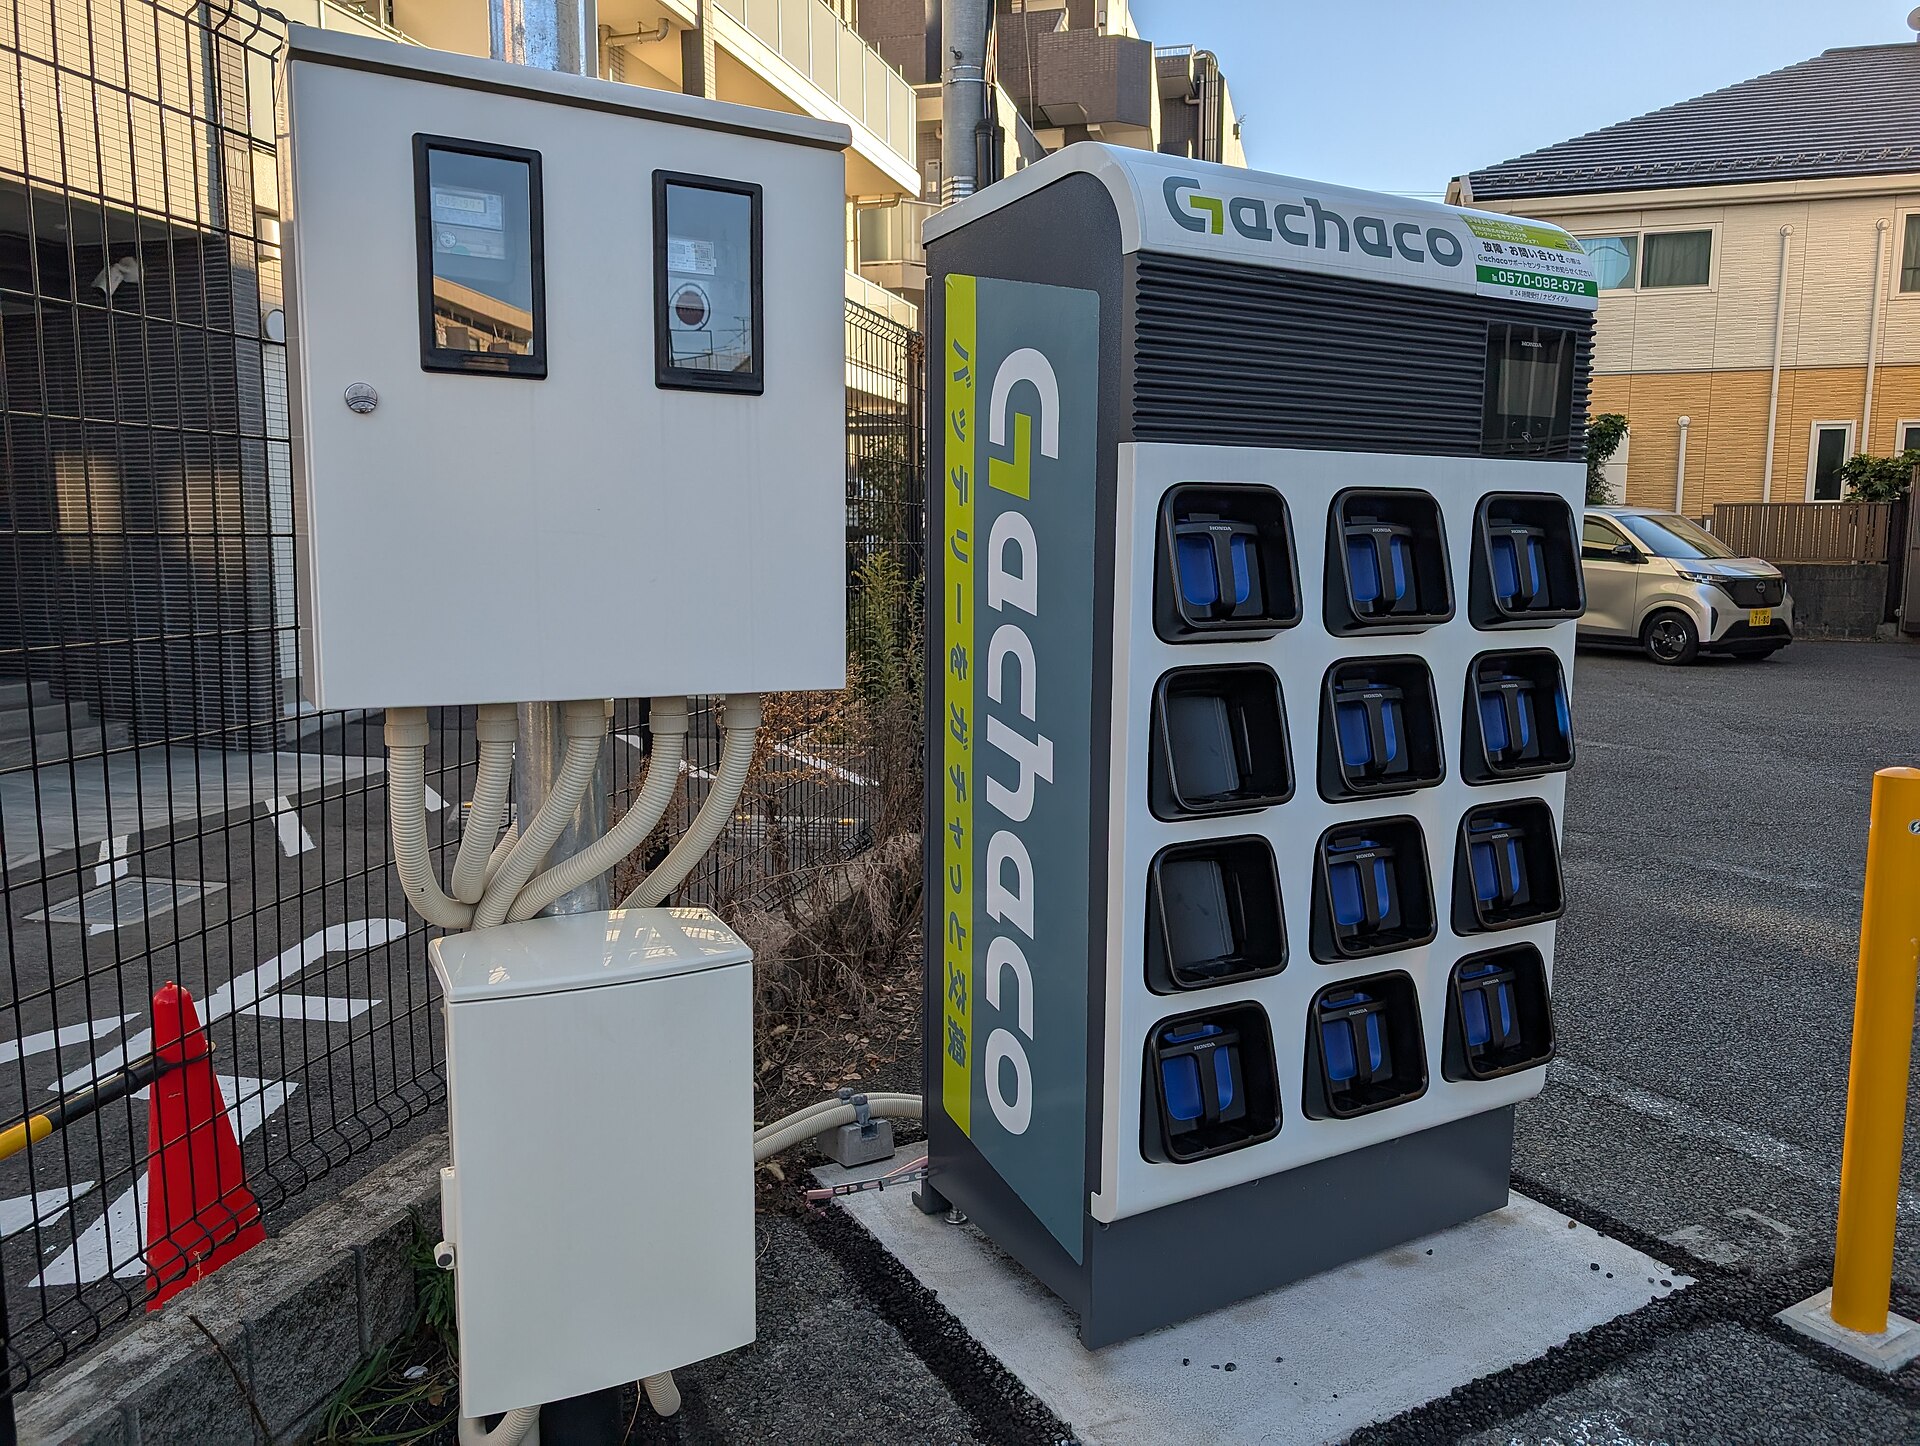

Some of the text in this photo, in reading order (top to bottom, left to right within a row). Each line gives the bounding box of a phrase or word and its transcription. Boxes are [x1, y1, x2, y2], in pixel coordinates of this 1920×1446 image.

[1163, 176, 1463, 267] Gachaco
[1463, 215, 1494, 227] SWAP
[1507, 222, 1524, 231] GO
[1498, 271, 1585, 293] 0570-092-672
[947, 338, 972, 1068] バッテリーをガチャっと交換
[985, 347, 1060, 1135] Gachaco
[1482, 978, 1500, 986] HONDA
[1349, 1008, 1368, 1016] HONDA
[1194, 1042, 1216, 1050] HONDA
